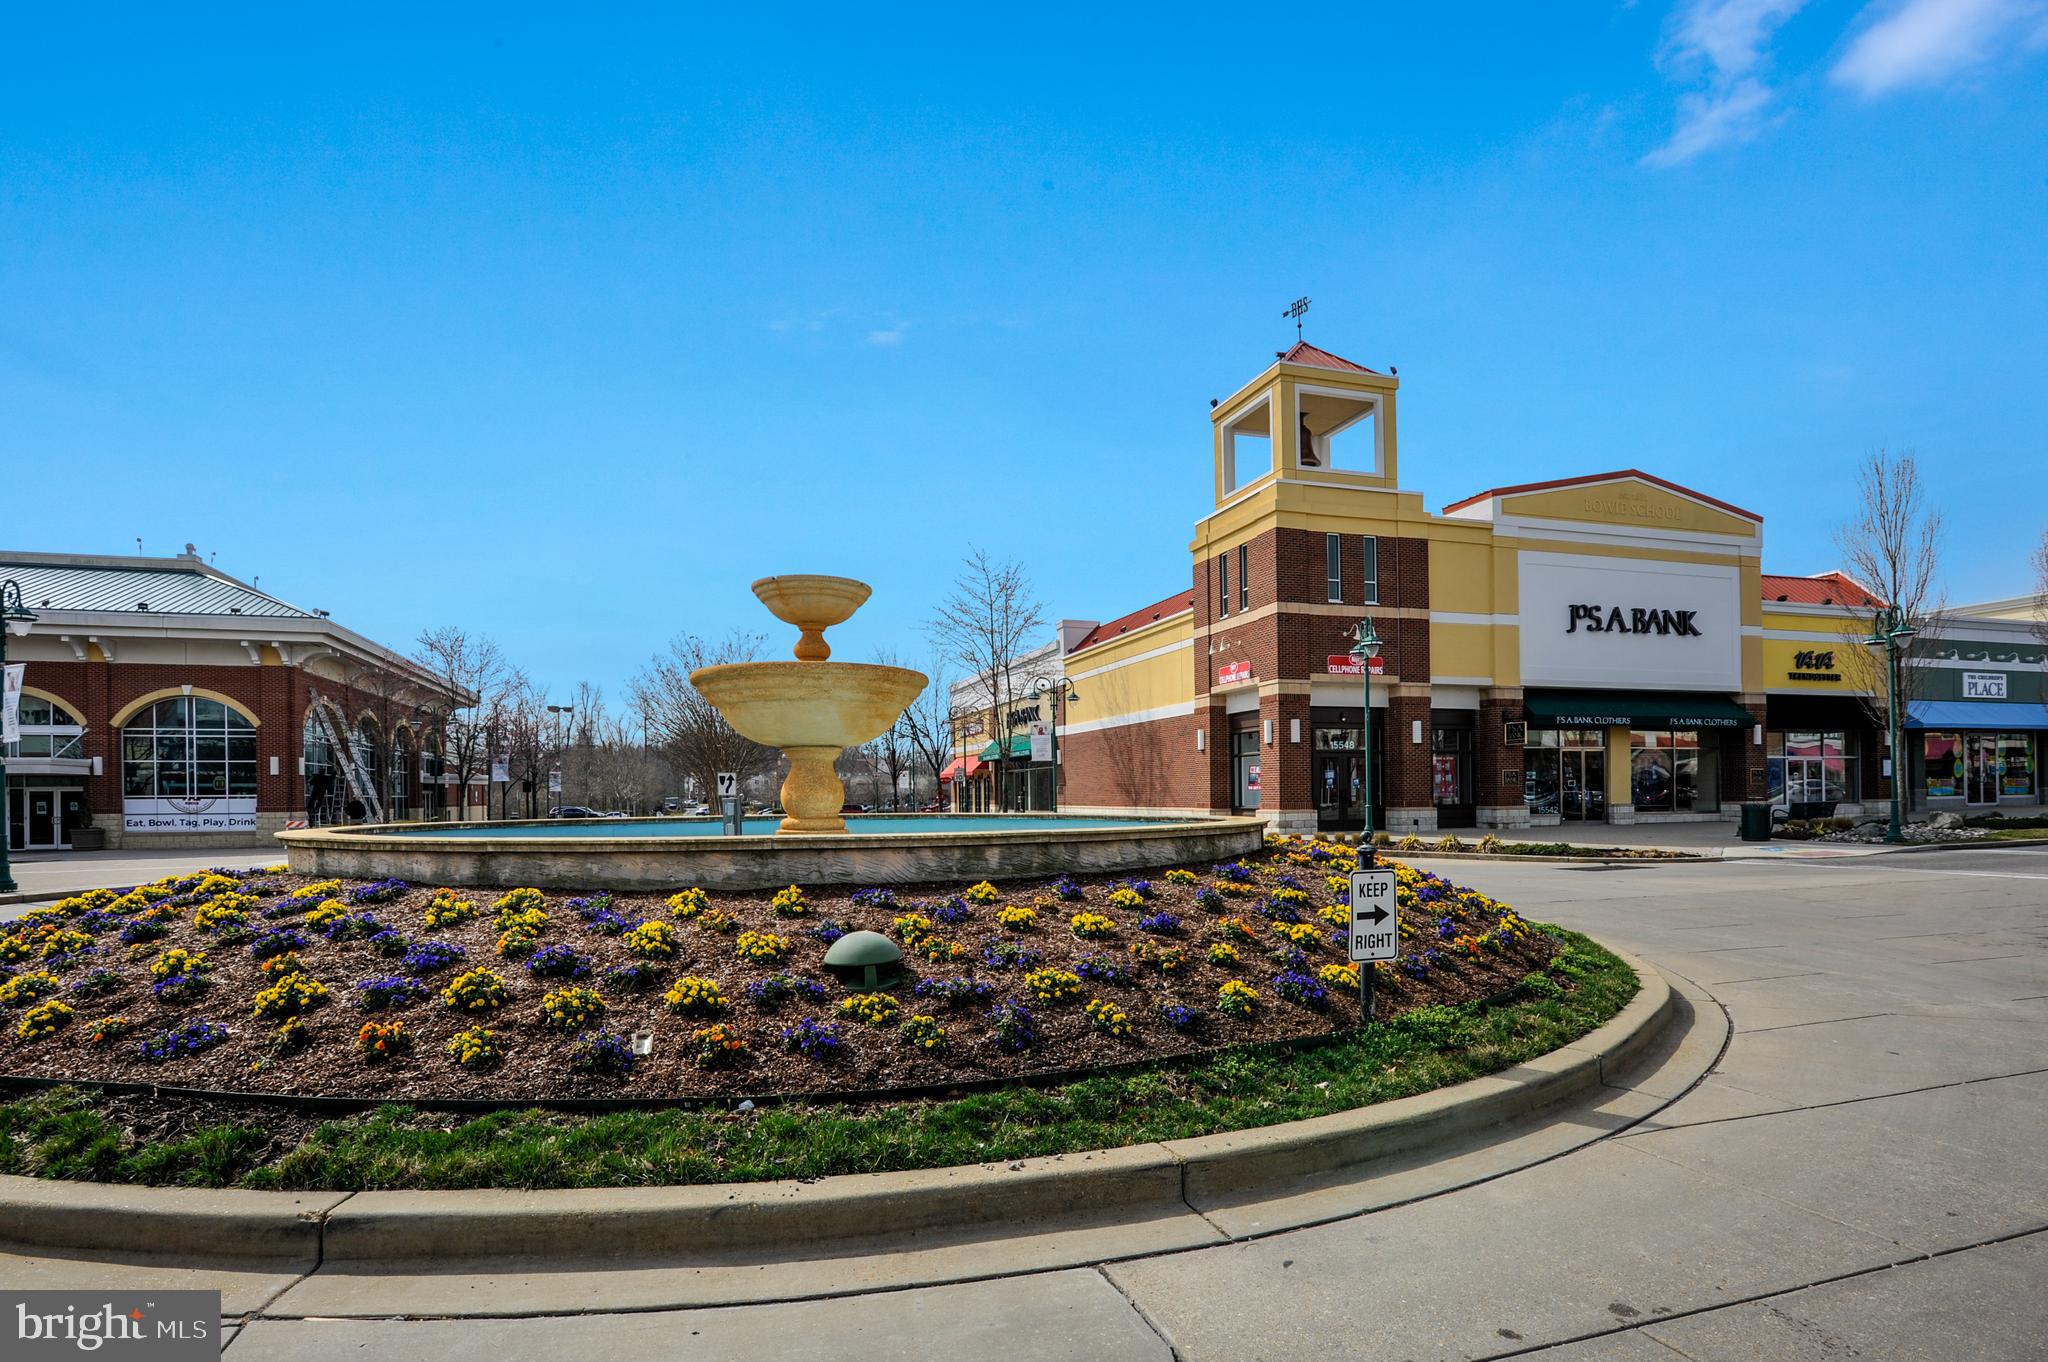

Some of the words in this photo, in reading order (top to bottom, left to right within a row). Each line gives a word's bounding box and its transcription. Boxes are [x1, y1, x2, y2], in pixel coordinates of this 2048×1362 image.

[1291, 297, 1309, 318] BHS
[1584, 497, 1626, 515] BOWIE
[1630, 504, 1681, 521] SCHOOL
[1329, 665, 1360, 674] CELLPHONE
[1968, 682, 2004, 697] PLACE
[1594, 717, 1631, 725] CLOTHIERS
[1704, 718, 1738, 727] CLOTHIERS
[1331, 740, 1355, 750] 15548
[1538, 806, 1559, 814] 15542
[229, 817, 257, 826] Drink
[1359, 882, 1388, 898] KEEP
[1355, 933, 1392, 950] RIGHT
